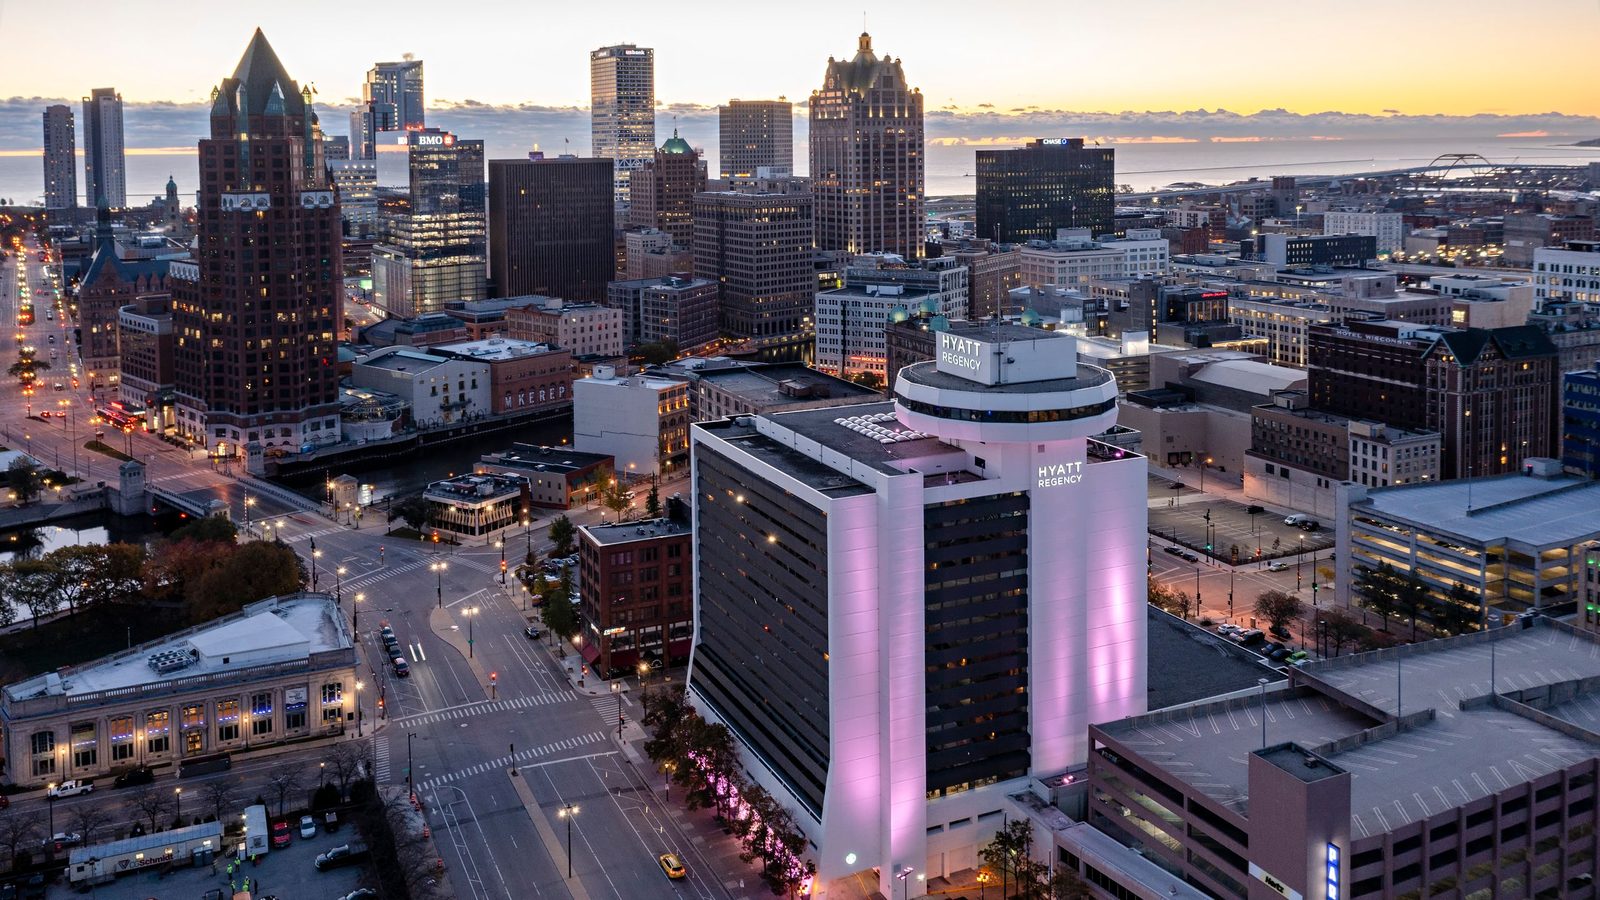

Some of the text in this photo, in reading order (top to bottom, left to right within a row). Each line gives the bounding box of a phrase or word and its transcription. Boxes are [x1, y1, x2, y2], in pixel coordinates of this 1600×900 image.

[419, 136, 443, 145] BMO
[942, 334, 981, 357] HYATT
[1336, 330, 1411, 346] HOTEL WISCONSIN
[942, 351, 981, 370] REGENCY
[1038, 461, 1083, 478] HYATT
[1038, 474, 1083, 488] REGENCY
[1265, 876, 1285, 893] Hertz
